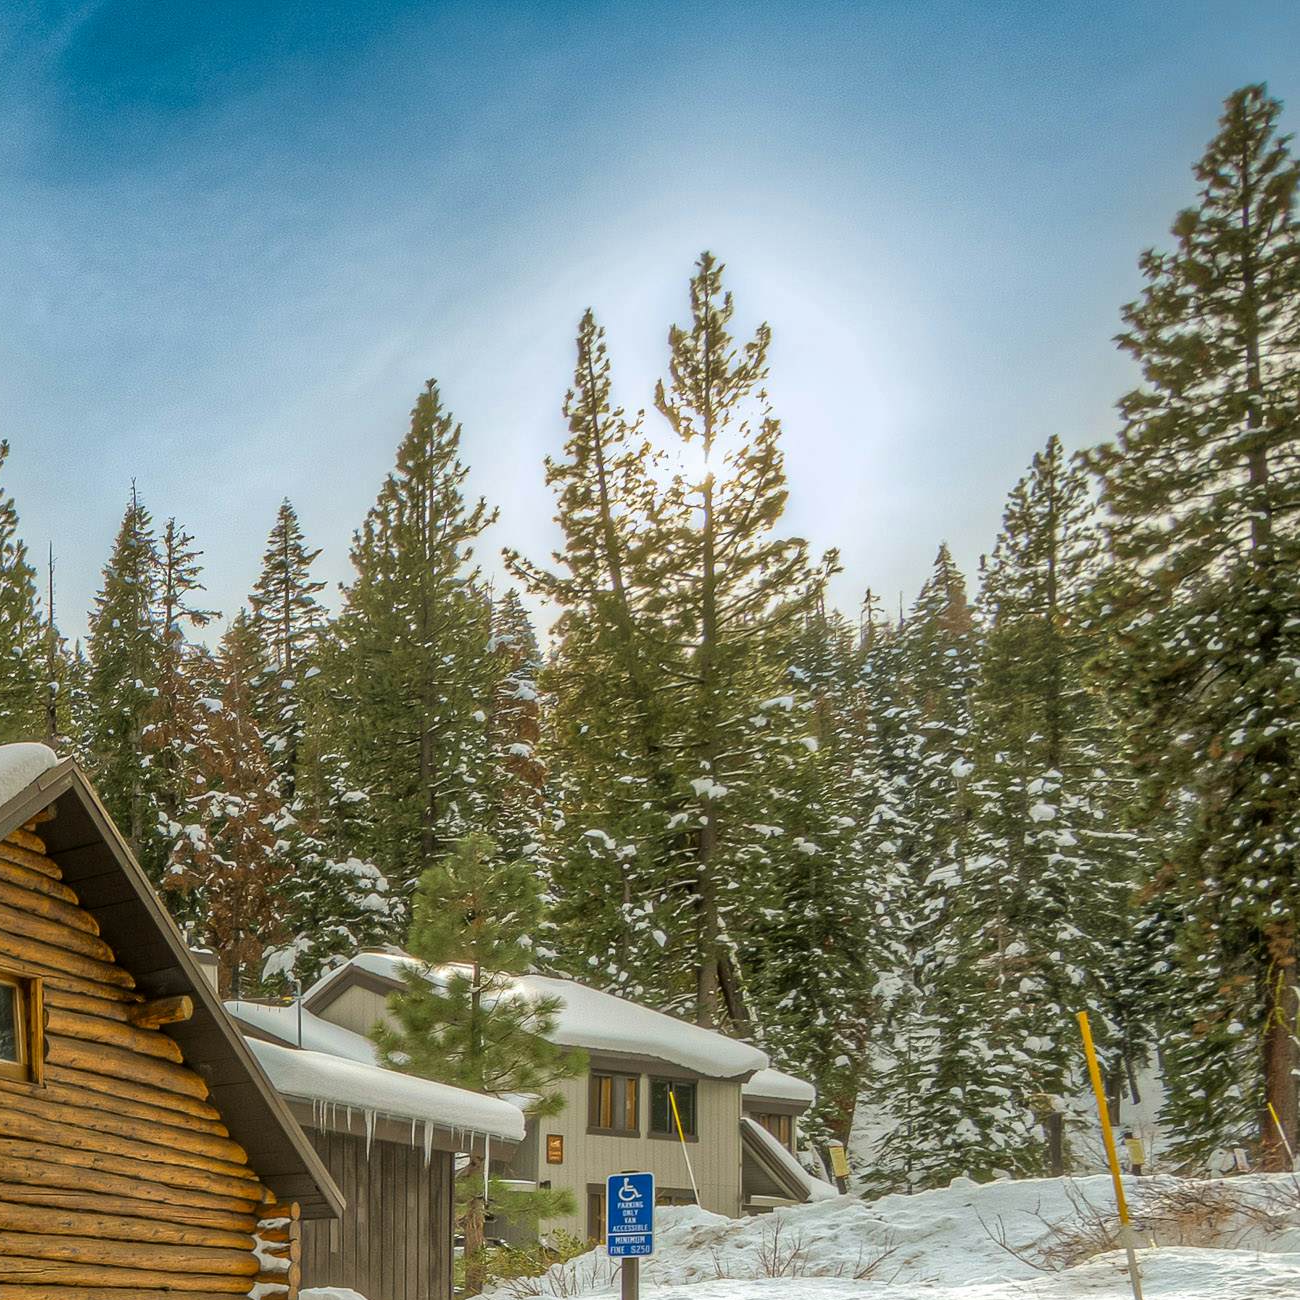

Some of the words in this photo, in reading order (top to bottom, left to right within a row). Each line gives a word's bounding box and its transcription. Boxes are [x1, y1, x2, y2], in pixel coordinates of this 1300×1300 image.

[617, 1201, 644, 1209] PARKING
[622, 1209, 639, 1217] ONLY
[612, 1224, 649, 1232] ACCESSIBLE
[615, 1235, 646, 1245] MINIMUM
[610, 1246, 625, 1254] FINE
